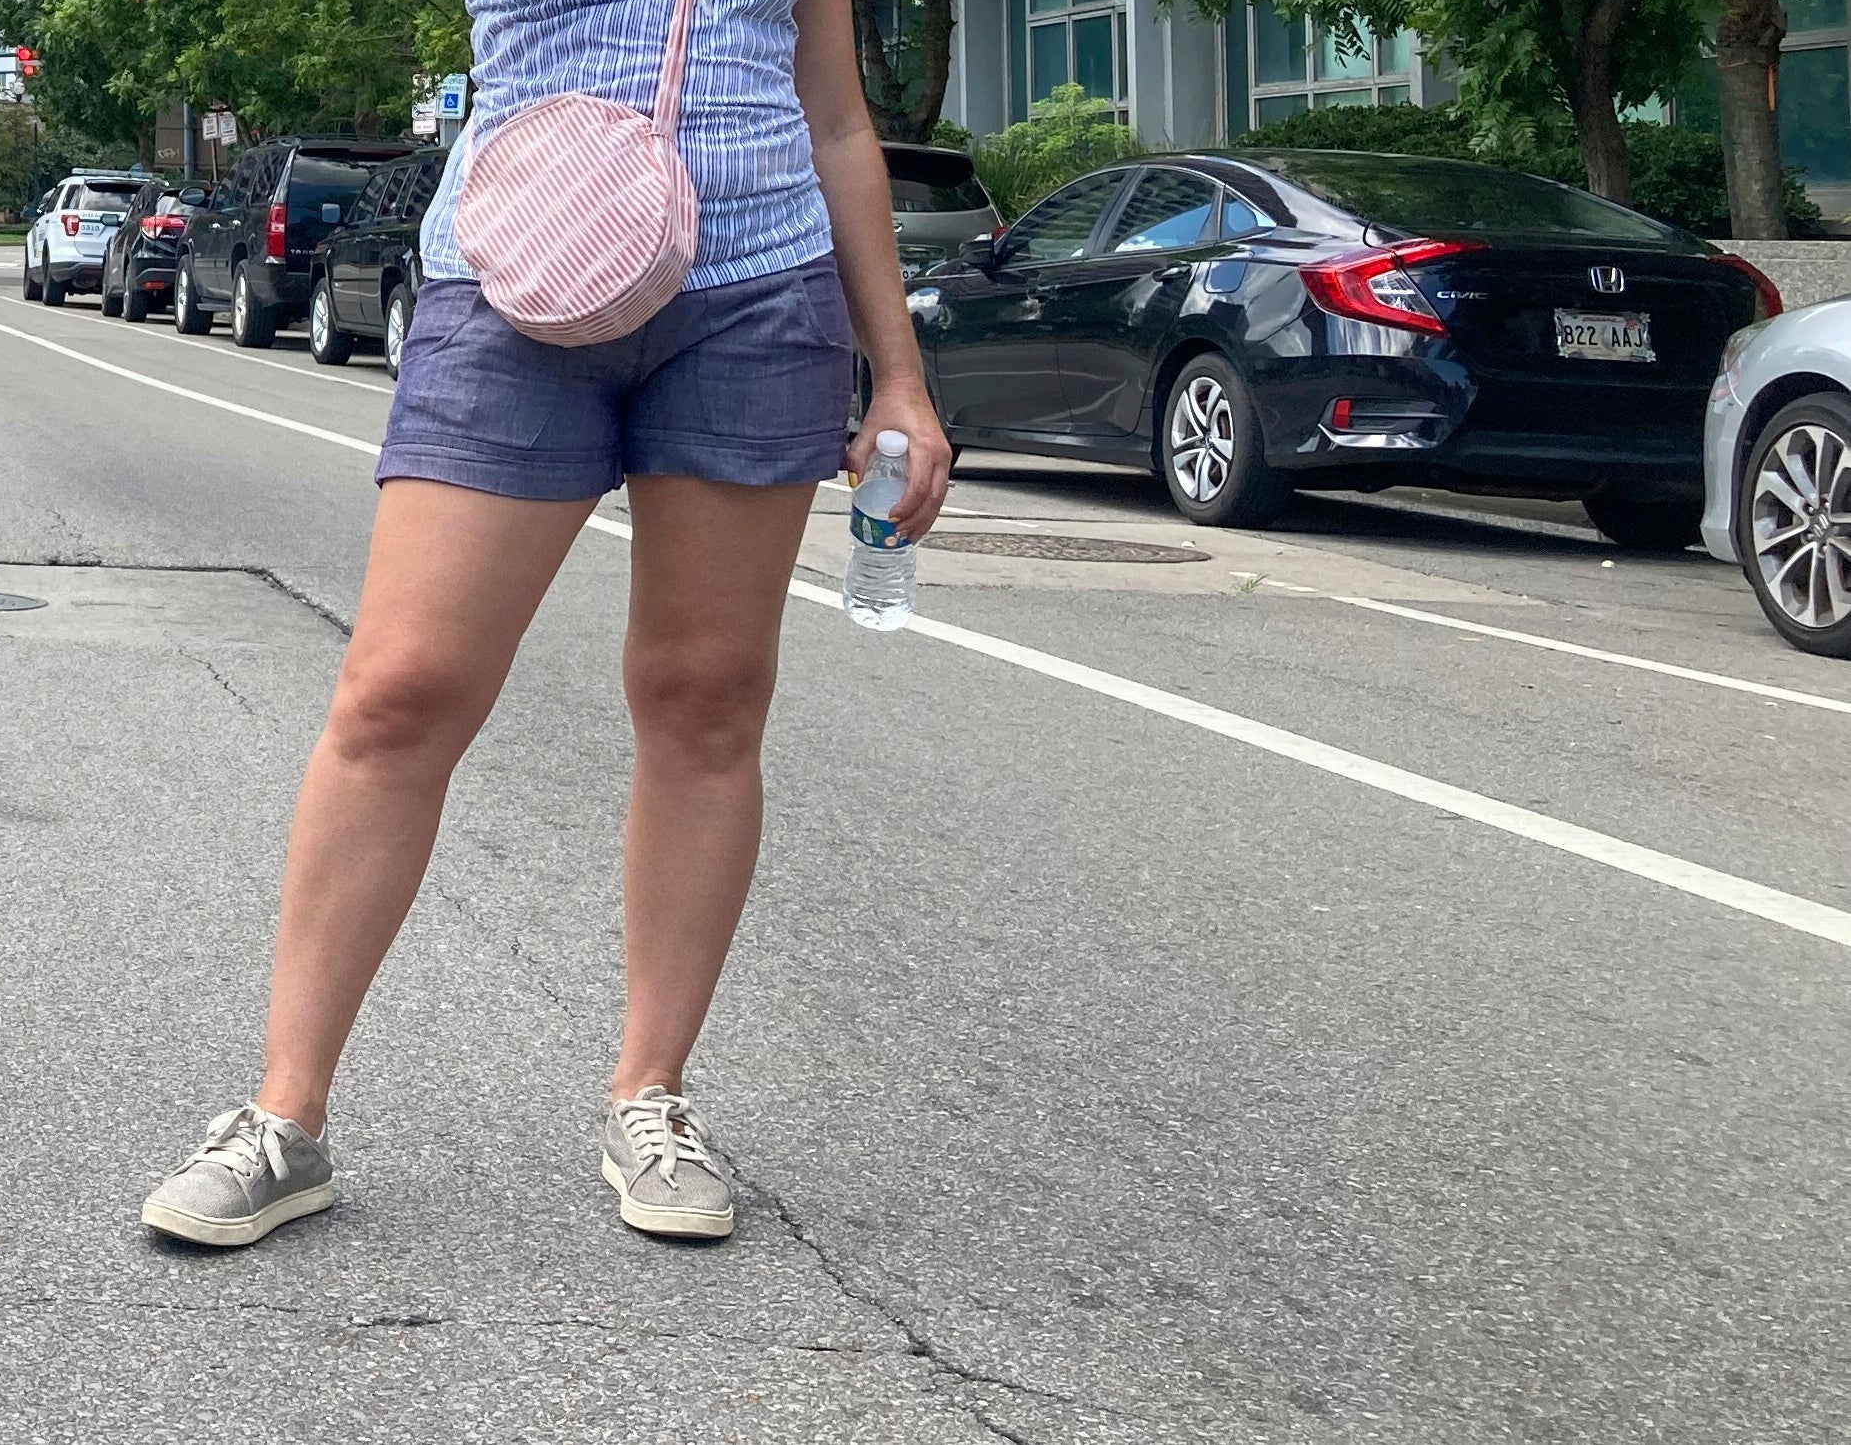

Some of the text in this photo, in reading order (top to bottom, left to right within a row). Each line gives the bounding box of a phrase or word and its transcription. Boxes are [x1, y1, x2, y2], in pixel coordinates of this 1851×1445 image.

[1436, 290, 1489, 300] CIVIC
[1564, 325, 1643, 348] 822 AAJ
